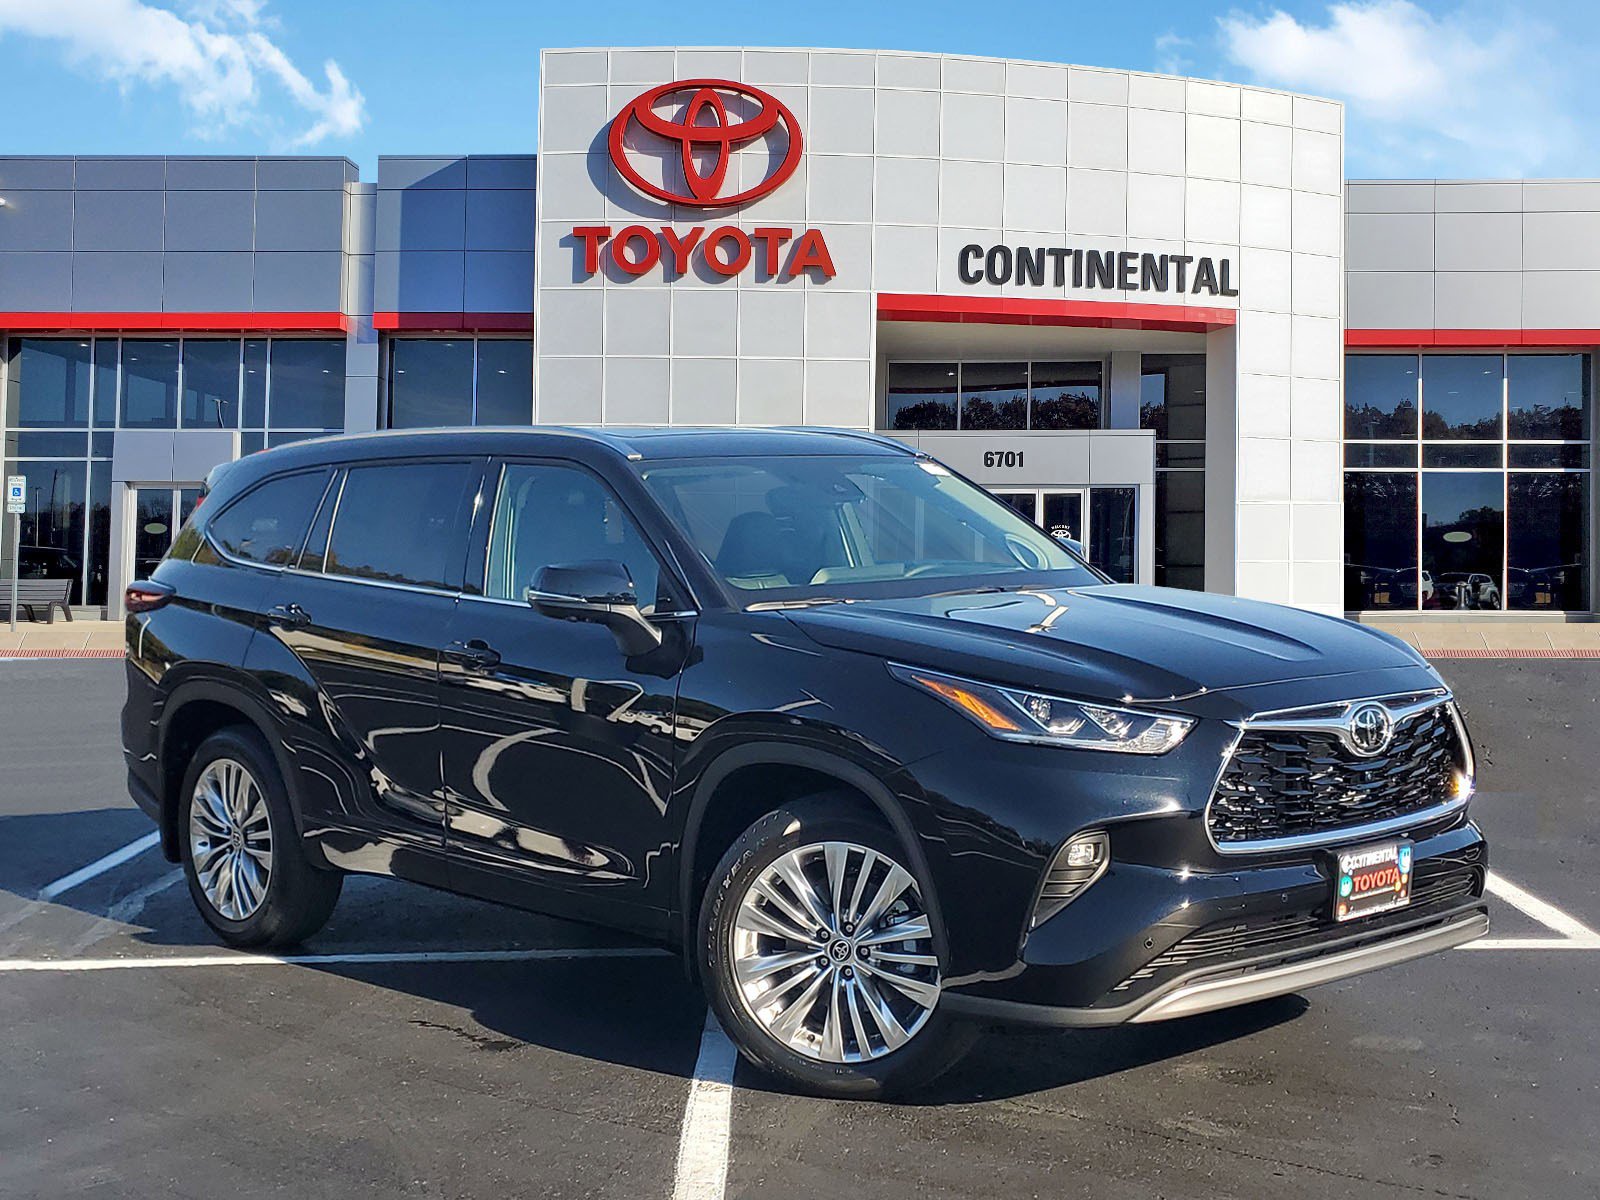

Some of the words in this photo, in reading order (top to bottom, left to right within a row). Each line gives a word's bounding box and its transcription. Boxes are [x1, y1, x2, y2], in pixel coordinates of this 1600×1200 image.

[573, 225, 837, 277] TOYOTA
[958, 244, 1239, 296] CONTINENTAL
[983, 451, 1024, 467] 6701
[1353, 867, 1400, 892] TOYOTA
